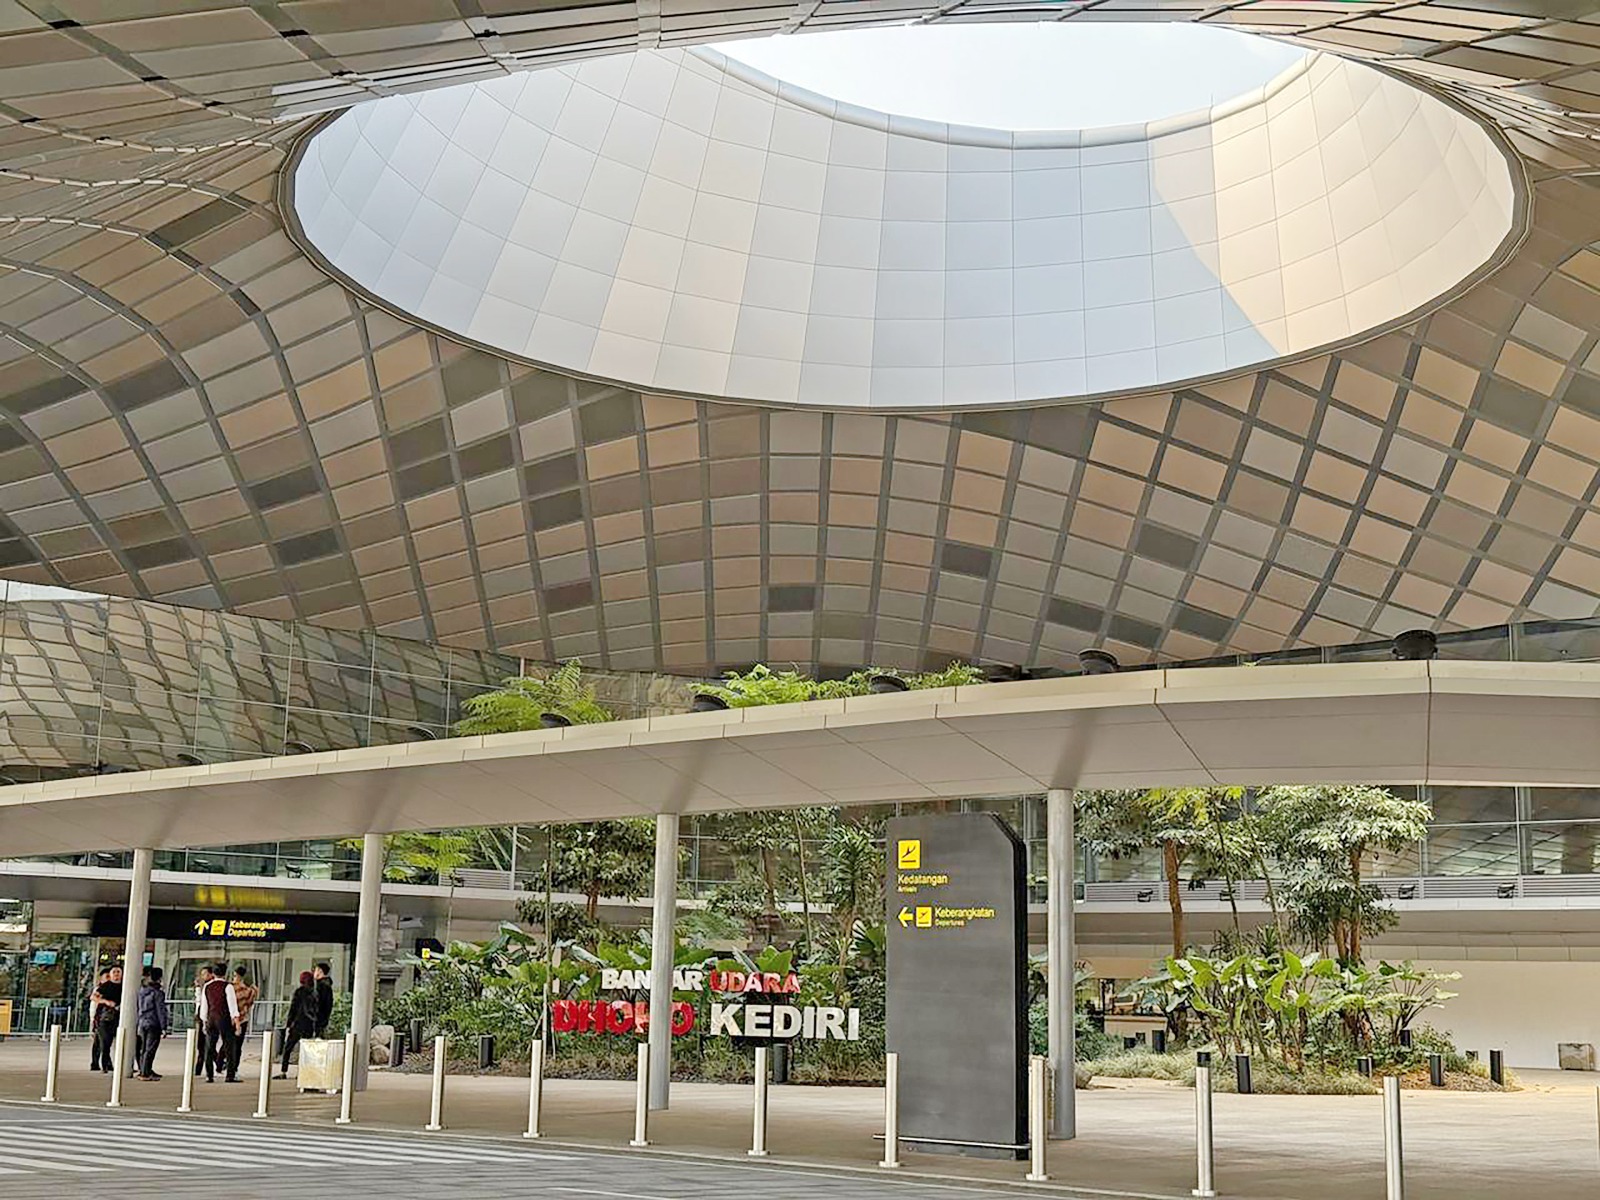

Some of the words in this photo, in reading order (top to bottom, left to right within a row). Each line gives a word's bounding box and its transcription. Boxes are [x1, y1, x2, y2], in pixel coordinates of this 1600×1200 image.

[897, 874, 948, 887] Kedatangan
[935, 907, 995, 920] Keberangkatan
[229, 920, 287, 931] Keberangkatan
[227, 928, 267, 938] Departures
[601, 969, 704, 991] BANAR
[709, 969, 800, 993] UDARA
[710, 1003, 860, 1041] KEDIRI
